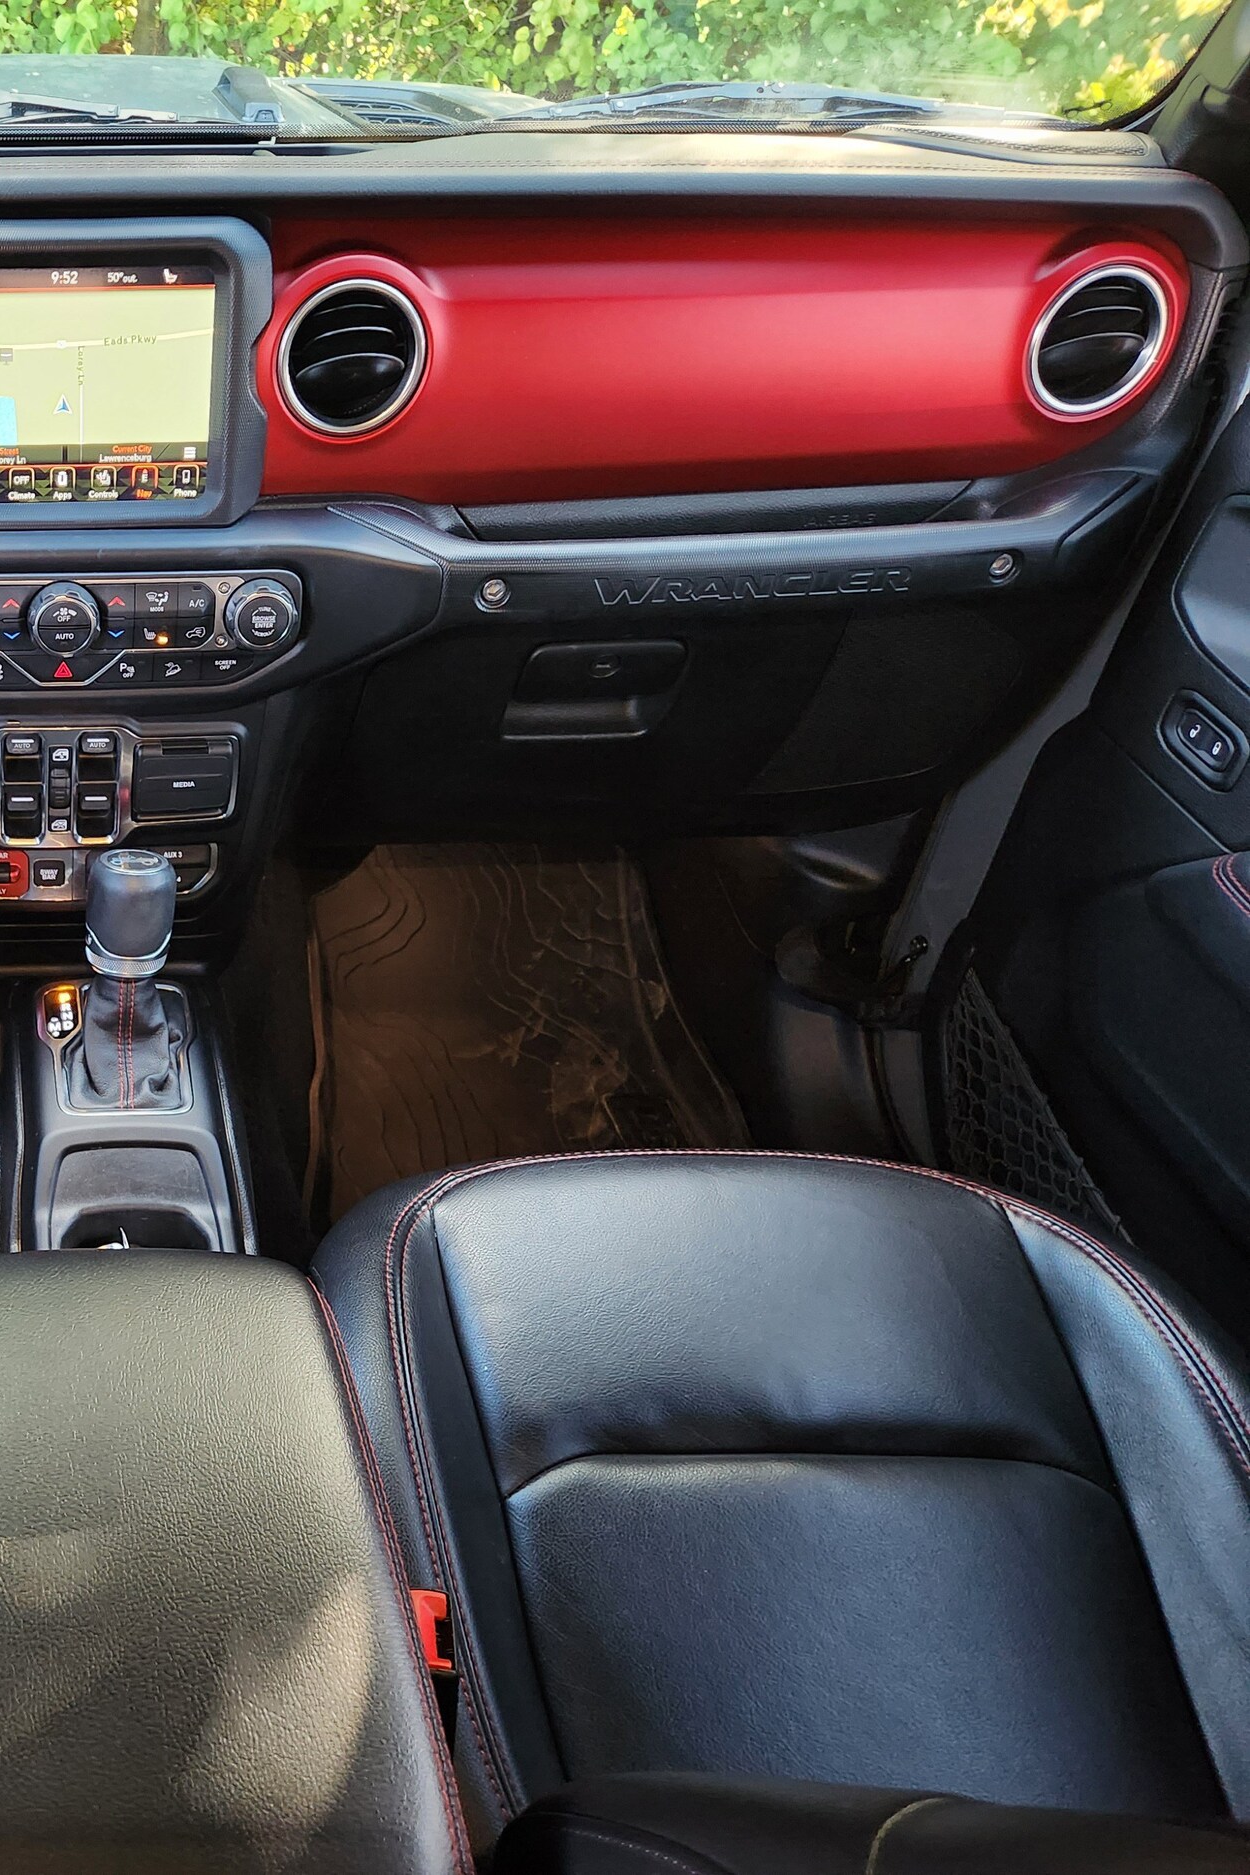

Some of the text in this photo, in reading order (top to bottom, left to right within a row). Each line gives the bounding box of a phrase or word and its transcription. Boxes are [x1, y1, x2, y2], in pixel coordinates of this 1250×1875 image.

[51, 271, 78, 284] 9:52
[103, 334, 157, 346] Eads Pkwy
[76, 345, 85, 386] Lorey Ln
[0, 447, 20, 456] Street
[112, 444, 153, 454] Current City
[16, 455, 27, 465] Ln
[99, 453, 153, 464] Lawrenceburg
[13, 475, 30, 485] OFF
[7, 491, 36, 501] Climate
[52, 491, 73, 501] Apps
[88, 489, 119, 499] Controls
[173, 488, 198, 498] Phone
[594, 566, 912, 605] WRANGLER
[188, 600, 205, 608] A/C
[57, 615, 71, 623] OFF
[55, 633, 75, 641] AUTO
[122, 671, 134, 679] OFF
[172, 780, 196, 788] MEDIA
[60, 1011, 74, 1021] N
[47, 1021, 62, 1033] M
[62, 1020, 75, 1031] D
